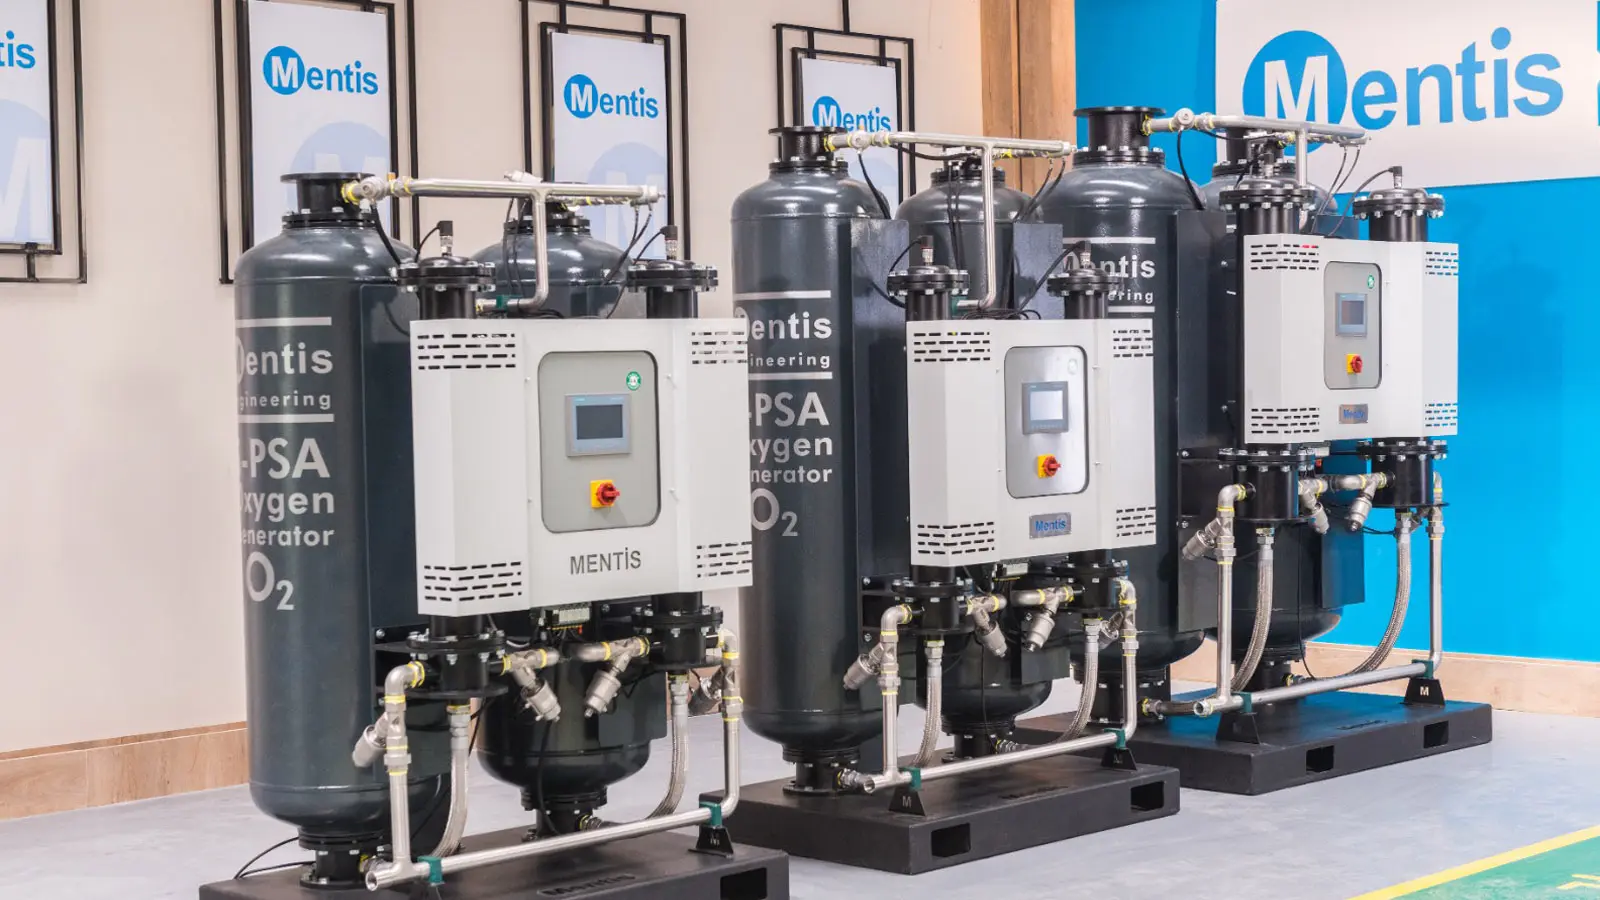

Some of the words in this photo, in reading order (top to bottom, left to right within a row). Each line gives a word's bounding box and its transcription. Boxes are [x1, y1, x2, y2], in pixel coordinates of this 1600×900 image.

[266, 48, 379, 95] Mentis
[1248, 27, 1563, 135] Mentis
[566, 76, 659, 119] Mentis
[814, 99, 892, 132] Mentis
